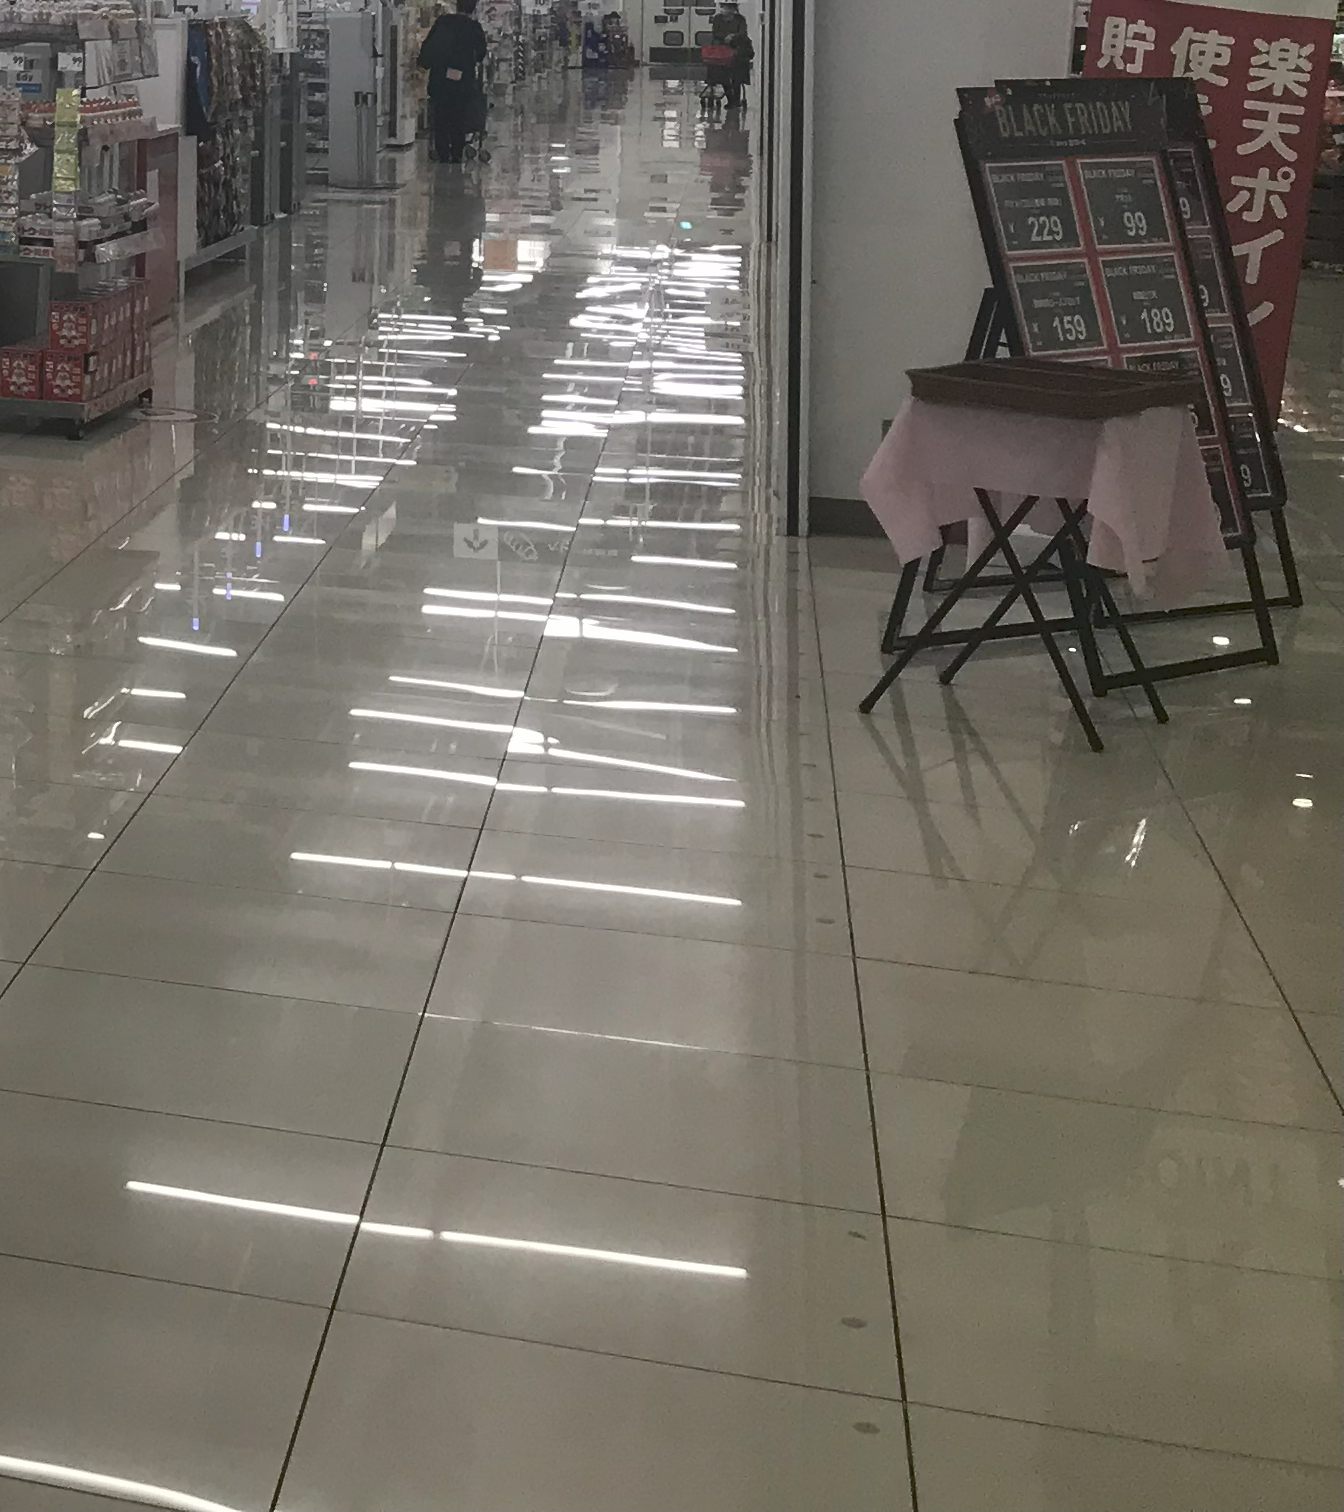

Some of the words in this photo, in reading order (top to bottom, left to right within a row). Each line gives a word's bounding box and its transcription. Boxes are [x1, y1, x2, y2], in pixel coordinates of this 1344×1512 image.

[1097, 16, 1156, 74] 貯
[1171, 26, 1236, 87] 使
[12, 56, 24, 66] 99
[71, 56, 83, 66] 99
[16, 73, 34, 82] Edy
[994, 102, 1063, 137] BLACK
[1063, 100, 1133, 135] FRIDAY
[1028, 215, 1063, 242] 229
[1123, 211, 1147, 236] 99
[1053, 314, 1087, 342] 159
[1141, 307, 1174, 334] 189
[1240, 464, 1253, 487] 9
